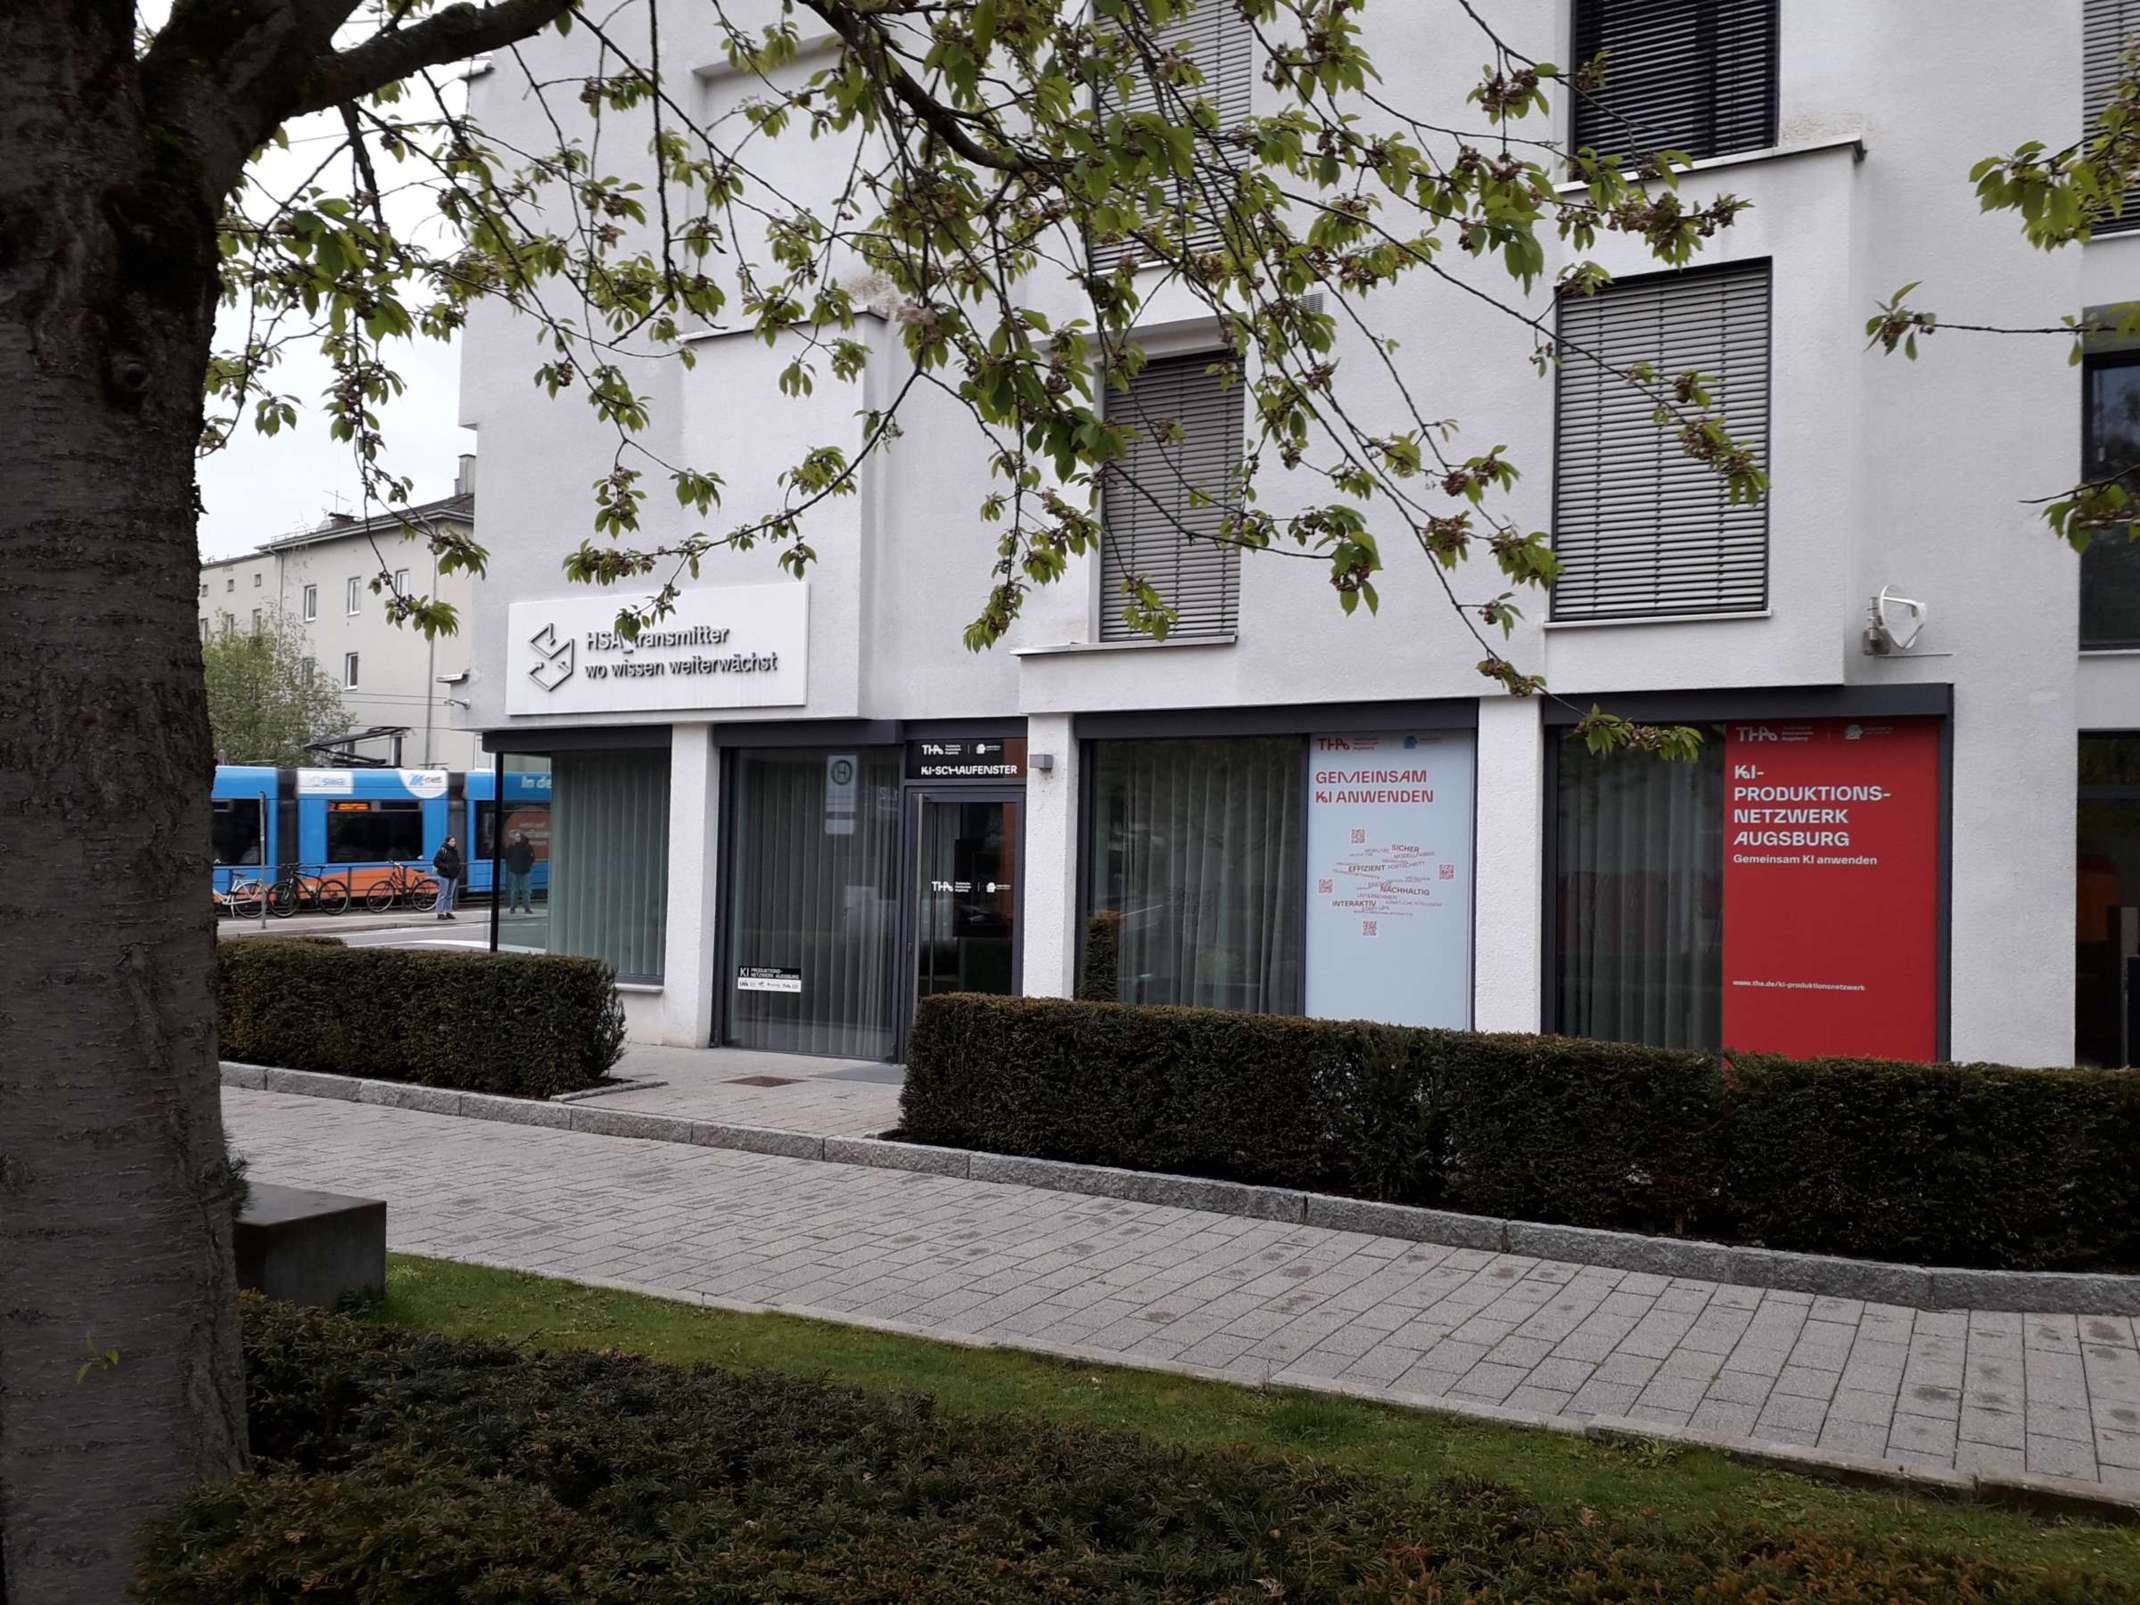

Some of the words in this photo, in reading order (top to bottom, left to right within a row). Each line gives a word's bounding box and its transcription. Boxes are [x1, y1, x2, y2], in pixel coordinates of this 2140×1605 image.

[585, 662, 608, 679] wo
[611, 659, 665, 678] wissen
[668, 651, 778, 675] weiterwächst
[921, 765, 1018, 776] KI-SCHAUFENSTER
[1315, 769, 1427, 785] GEMEINSAM
[1734, 765, 1765, 779] KI-
[1315, 791, 1333, 804] KI
[1336, 790, 1434, 804] ANWENDEN
[1734, 786, 1892, 801] PRODUKTIONS-
[1734, 808, 1849, 824] NETZWERK
[1733, 831, 1850, 847] AUGSBURG
[1733, 854, 1801, 864] Gemeinsam
[1803, 855, 1815, 864] KI
[1817, 856, 1878, 865] anwenden
[1348, 864, 1386, 873] EFFIZIENT
[1332, 900, 1377, 908] INTERAKTIV
[740, 967, 750, 978] KI
